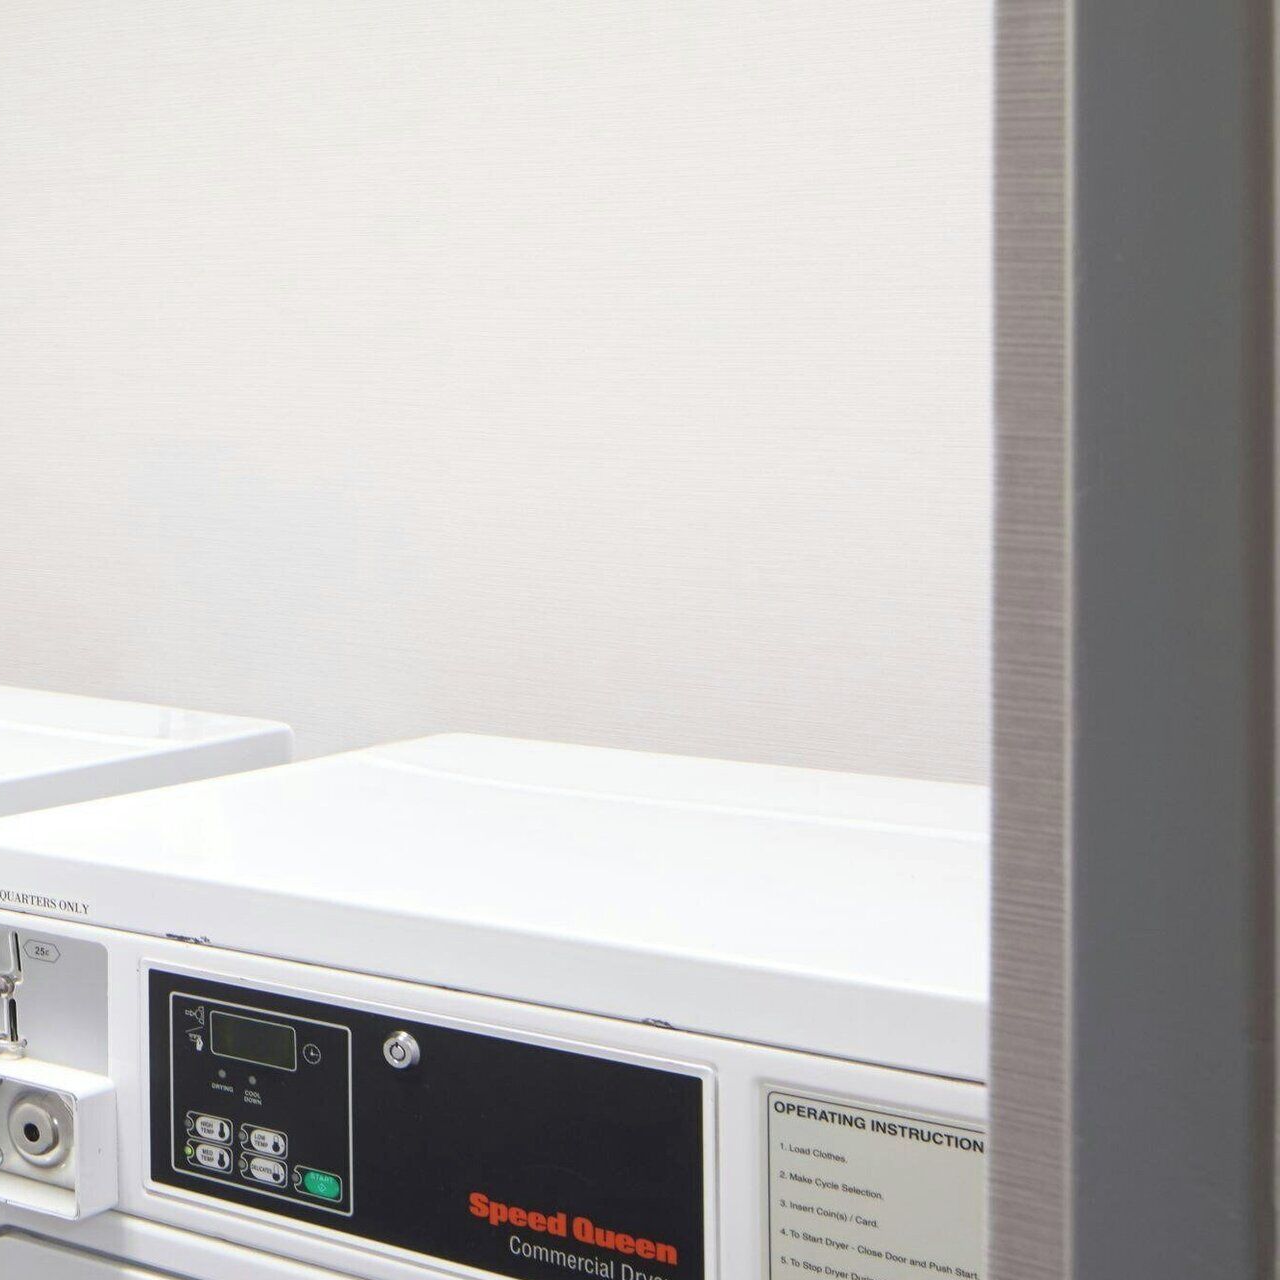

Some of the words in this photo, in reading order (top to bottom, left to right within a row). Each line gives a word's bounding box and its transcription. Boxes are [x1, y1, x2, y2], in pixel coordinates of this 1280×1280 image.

[0, 889, 57, 909] QUARTERS
[60, 900, 90, 915] ONLY
[211, 1082, 234, 1093] DRYING
[243, 1096, 262, 1106] DOWN
[244, 1090, 261, 1099] COOL
[201, 1121, 214, 1129] HIGH
[201, 1127, 215, 1135] TEMP
[774, 1100, 866, 1130] OPERATING
[871, 1119, 984, 1154] INSTRUCTION
[254, 1134, 266, 1142] LOW
[254, 1140, 269, 1148] TEMP
[201, 1154, 215, 1163] TEMP
[202, 1148, 214, 1156] MED
[780, 1142, 787, 1150] 1.
[789, 1143, 811, 1156] Load
[813, 1148, 848, 1164] Clothes.
[311, 1171, 333, 1184] START
[779, 1170, 788, 1180] 2.
[790, 1172, 813, 1185] Make
[815, 1178, 839, 1192] Cycle
[842, 1183, 884, 1200] Selection.
[780, 1199, 788, 1208] 3.
[790, 1202, 815, 1215] Insert
[817, 1207, 848, 1223] Coin(s)
[855, 1215, 880, 1229] Card.
[469, 1191, 567, 1238] Speed
[572, 1216, 678, 1265] Queen
[509, 1235, 614, 1279] Commercial
[780, 1228, 789, 1236] 4.
[790, 1229, 800, 1239] To
[802, 1232, 823, 1245] Start
[825, 1236, 849, 1251] Dryer
[858, 1245, 883, 1259] Close
[885, 1251, 907, 1264] Door
[909, 1257, 927, 1269] and
[929, 1261, 953, 1275] Push
[955, 1267, 980, 1280] Start.
[780, 1255, 789, 1265] 5.
[790, 1257, 800, 1268] To
[803, 1261, 822, 1274] Stop
[825, 1265, 849, 1280] Dryer
